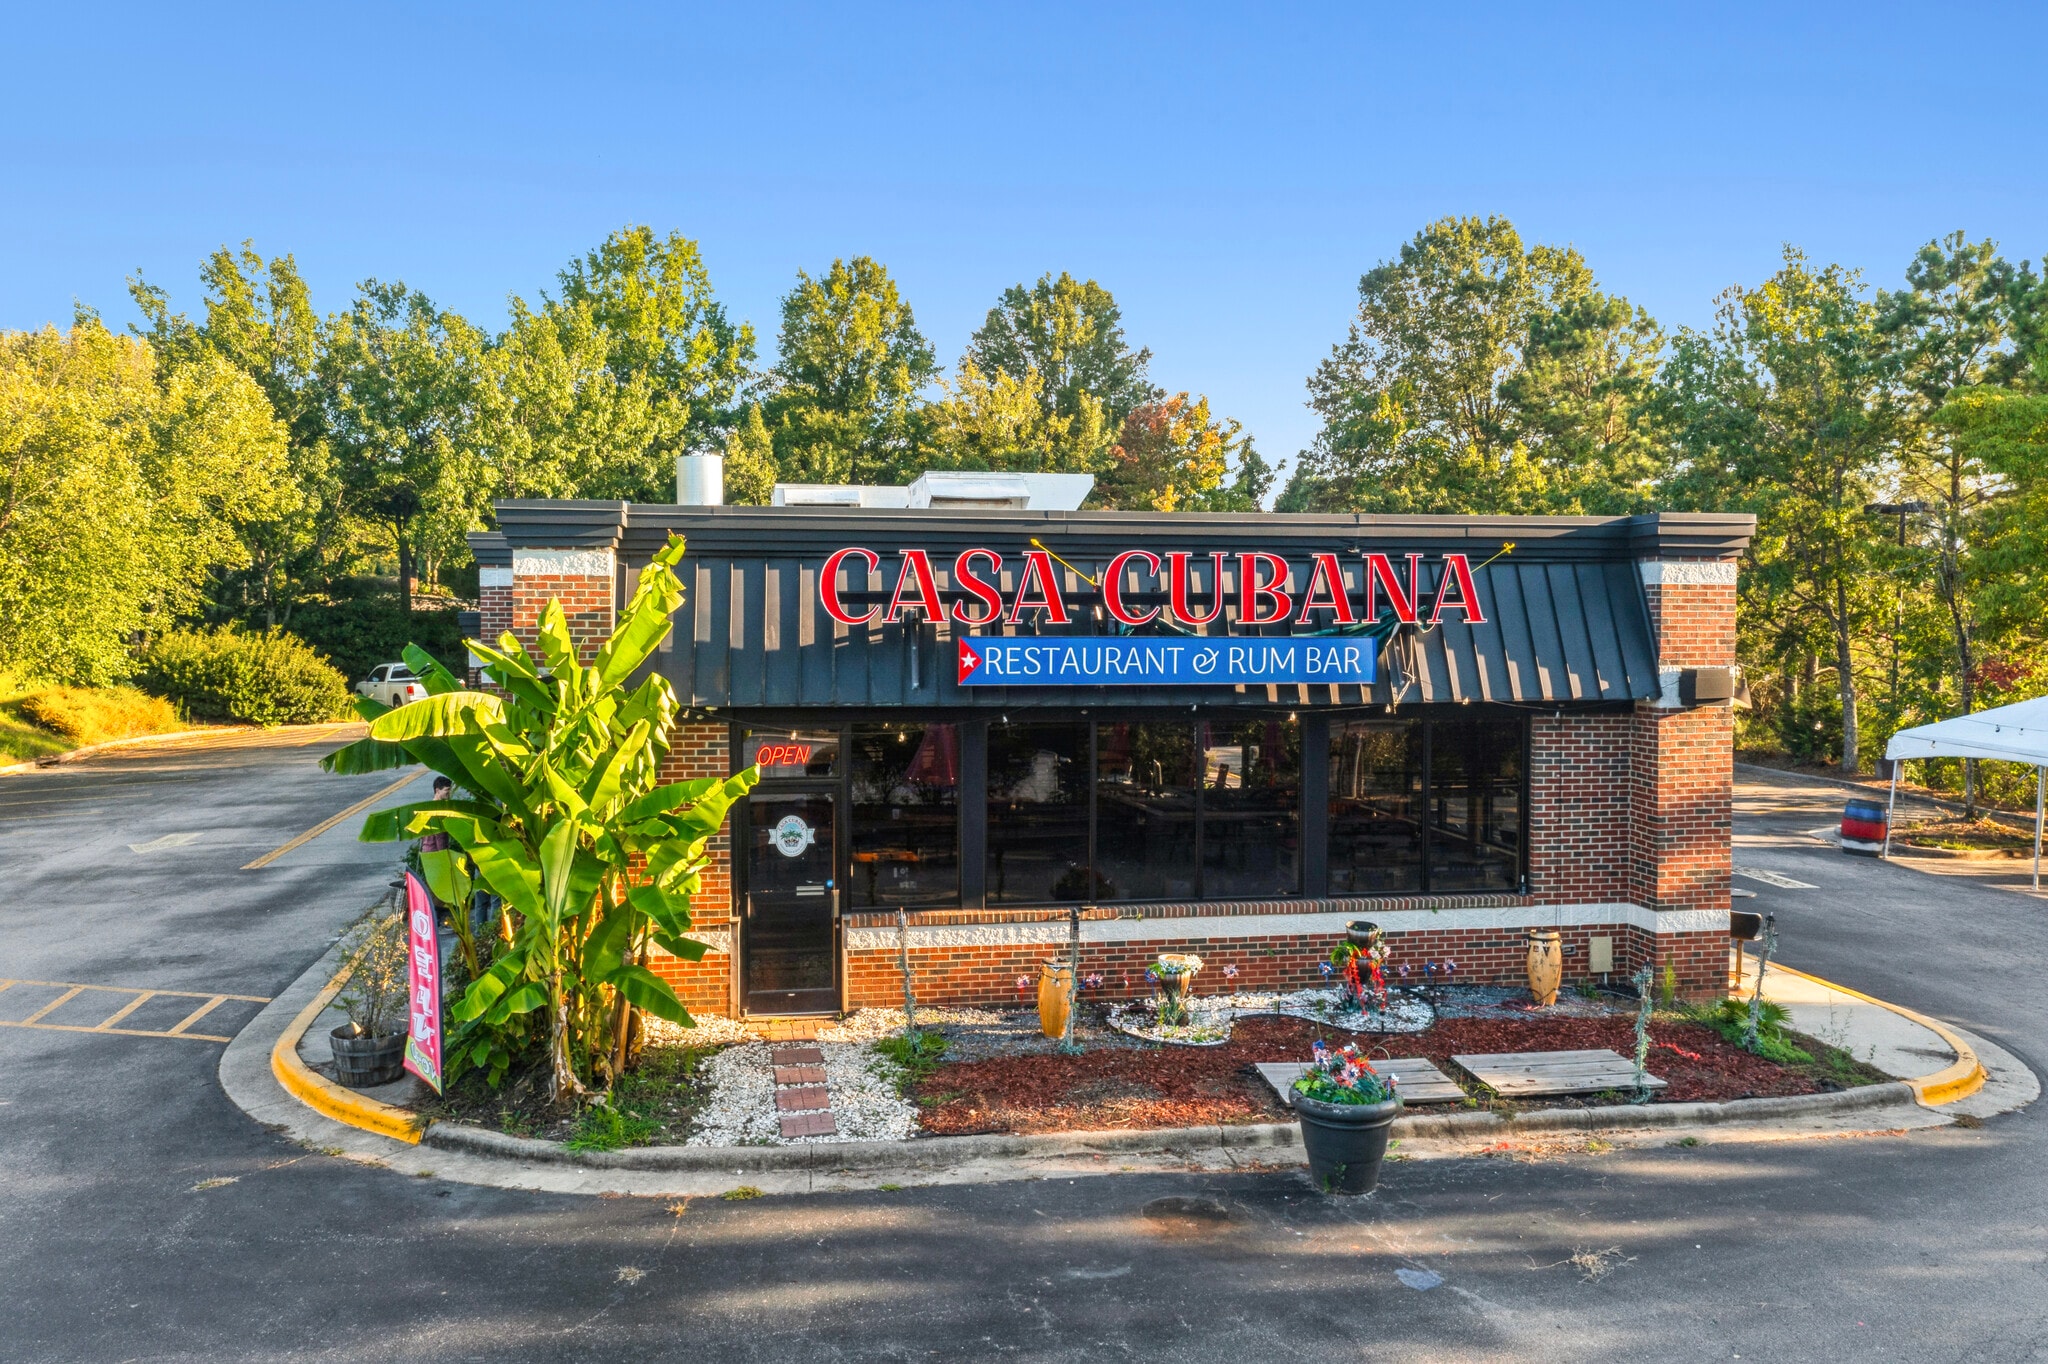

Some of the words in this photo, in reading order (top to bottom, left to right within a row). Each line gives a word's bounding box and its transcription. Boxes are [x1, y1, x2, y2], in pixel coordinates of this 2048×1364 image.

[819, 547, 1072, 625] CASA
[1103, 550, 1487, 625] CUBANA
[985, 646, 1185, 675] RESTAURANT
[1192, 649, 1220, 675] &
[1228, 646, 1295, 674] RUM
[1306, 646, 1361, 674] BAR
[756, 745, 811, 766] OPEN
